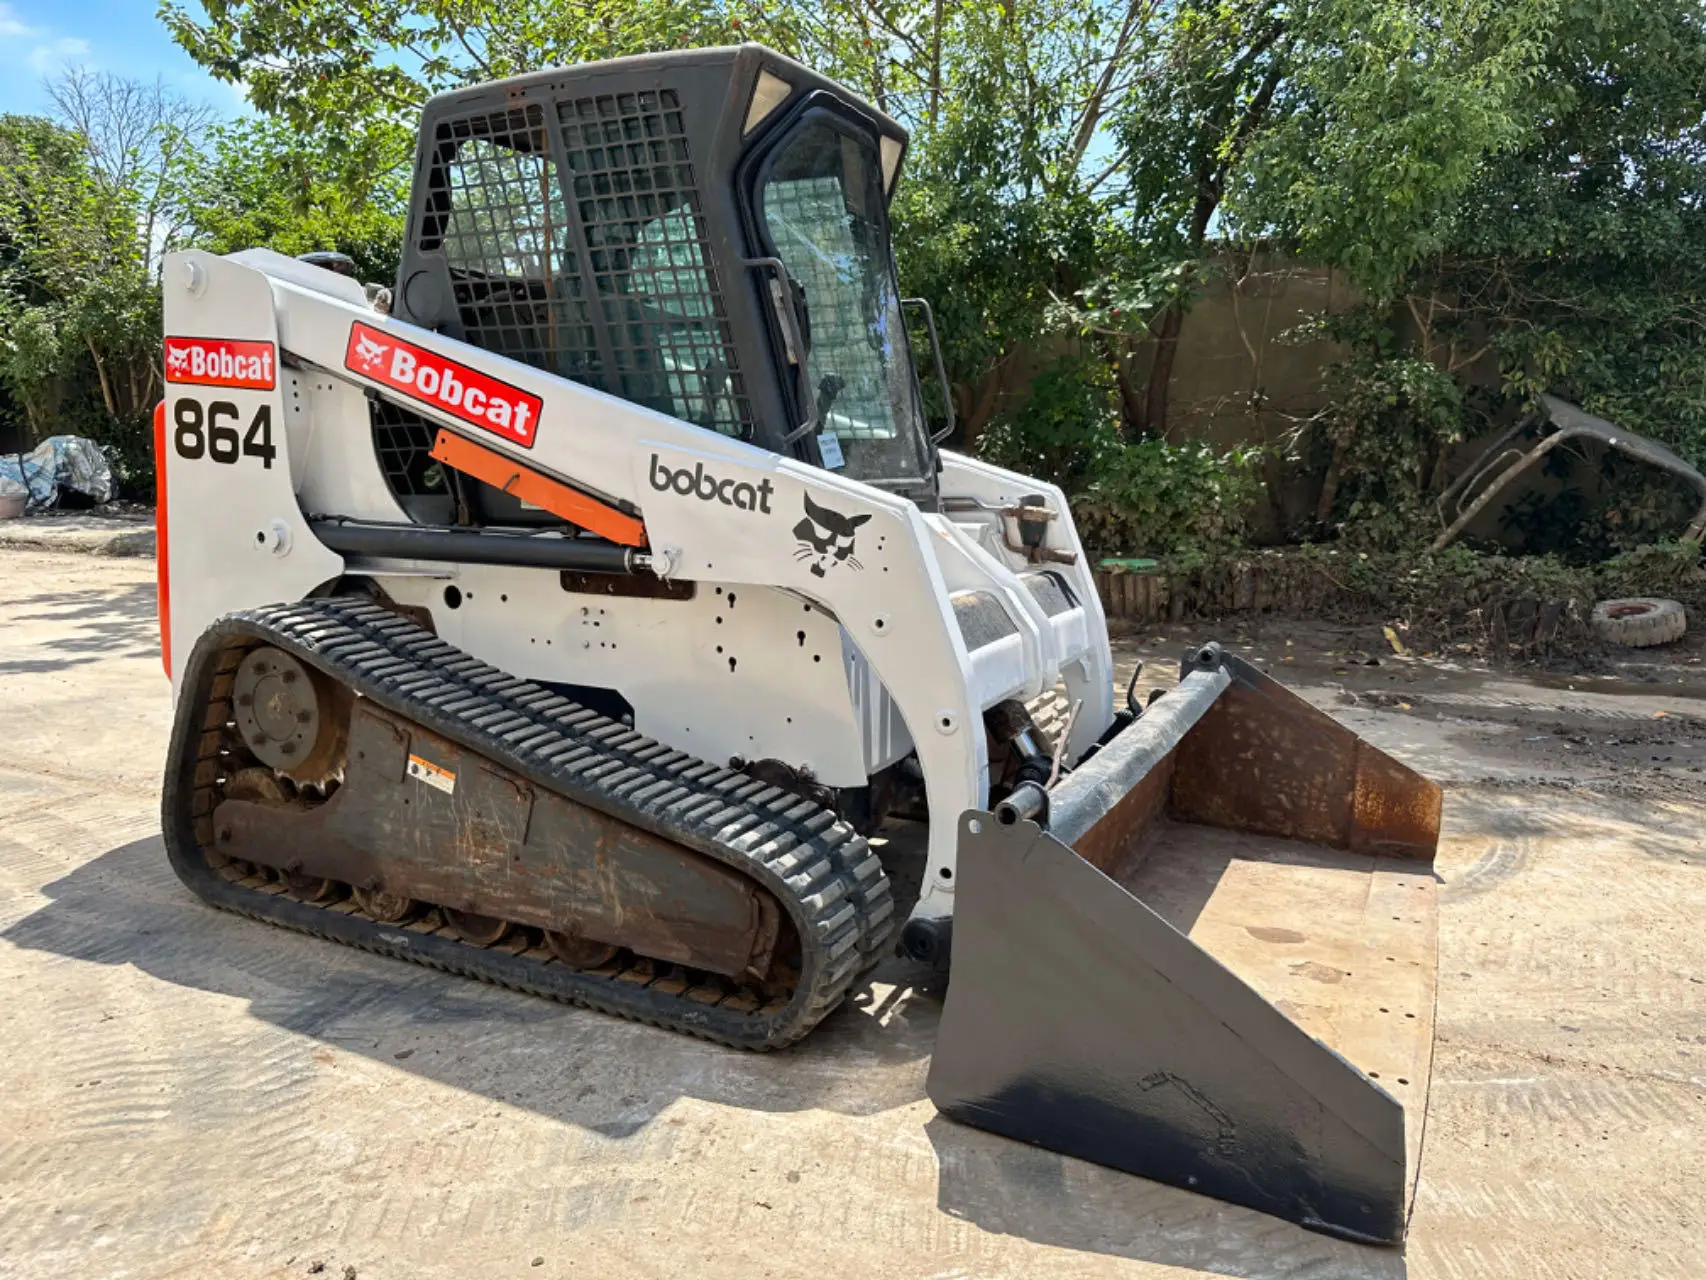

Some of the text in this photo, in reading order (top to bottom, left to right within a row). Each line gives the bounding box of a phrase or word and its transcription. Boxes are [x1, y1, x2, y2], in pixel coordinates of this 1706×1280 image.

[191, 347, 272, 382] Bobcat
[390, 350, 531, 436] Bobcat
[174, 398, 276, 469] 864
[650, 453, 774, 514] bobcat
